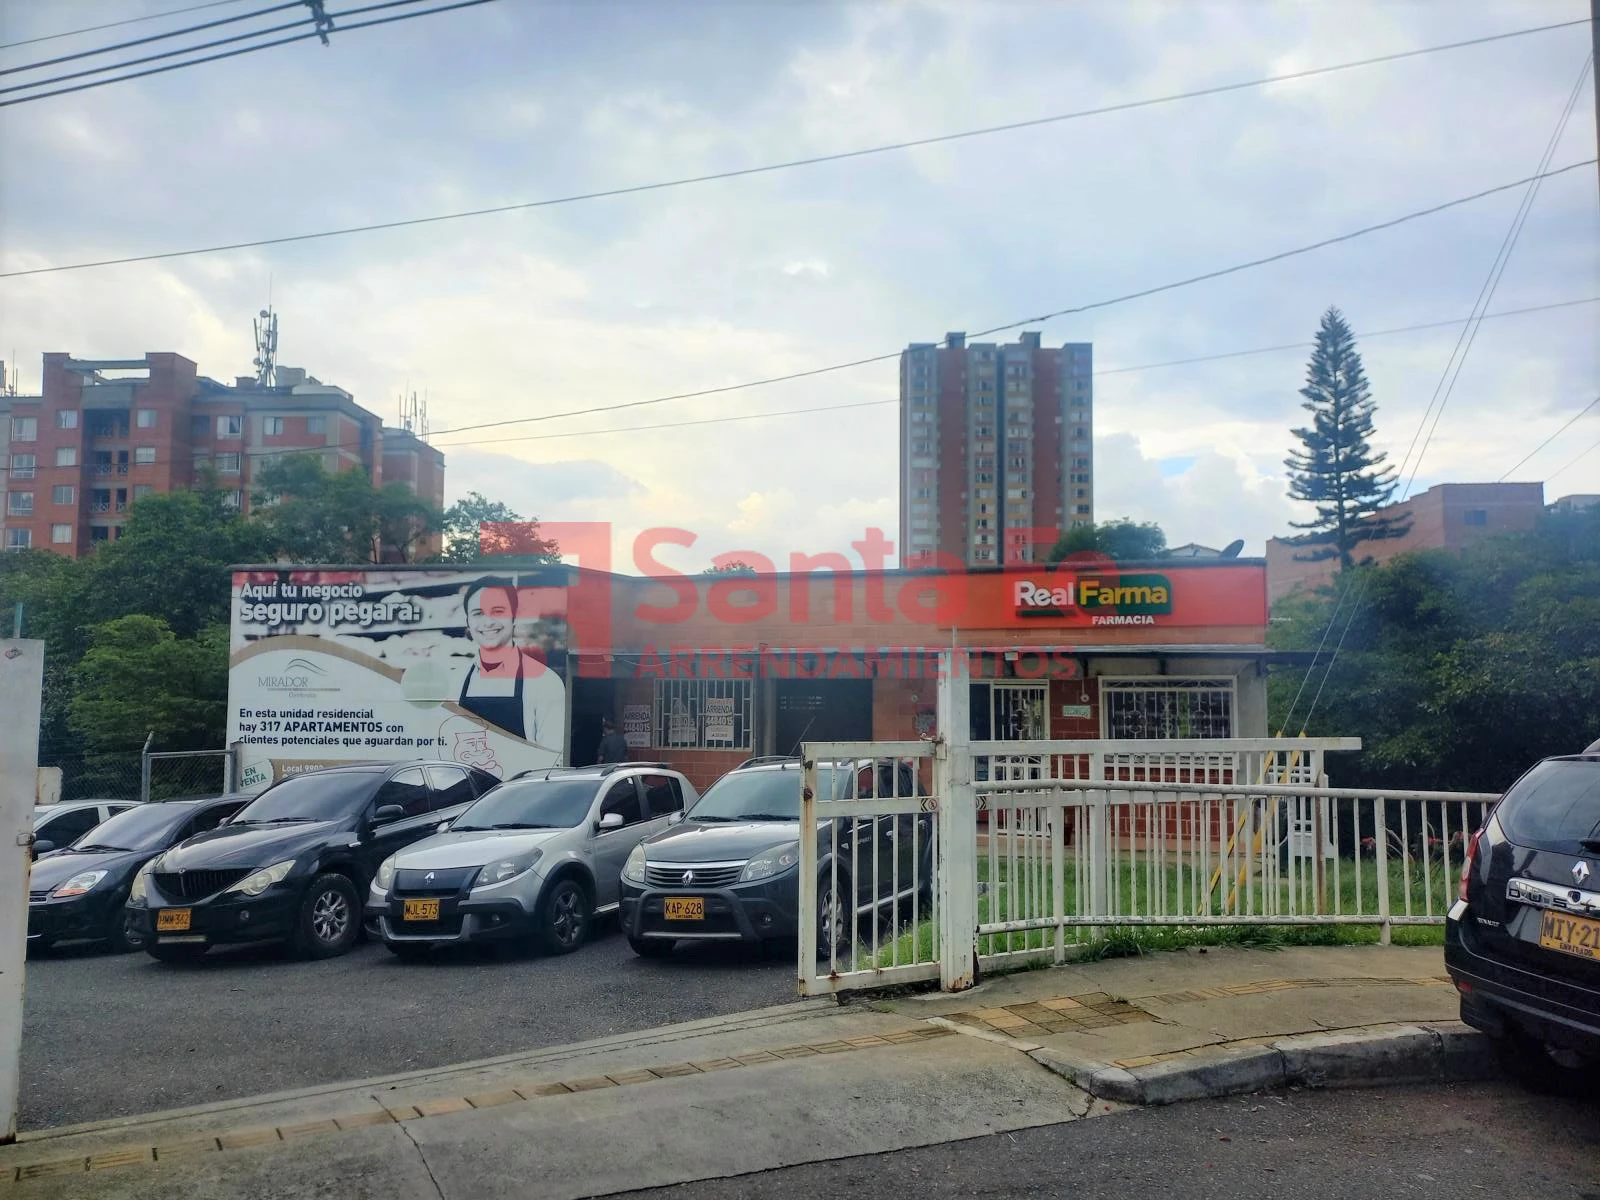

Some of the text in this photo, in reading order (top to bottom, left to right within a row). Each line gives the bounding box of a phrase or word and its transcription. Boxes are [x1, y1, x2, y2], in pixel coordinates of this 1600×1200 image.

[241, 581, 363, 601] Aquí tu negocio
[1014, 580, 1168, 607] Real Farma
[240, 602, 323, 625] seguro
[1092, 615, 1154, 625] FARMACIA
[258, 676, 308, 687] MIRADOR
[240, 709, 374, 719] En esta unidad residencial
[239, 722, 404, 733] hay 317 APARTAMENTOS con
[239, 735, 278, 745] clientes
[282, 736, 339, 746] potenciales
[343, 738, 361, 747] que
[365, 736, 413, 747] aguardan
[417, 738, 434, 747] por
[244, 766, 257, 777] EN
[282, 764, 303, 773] Local
